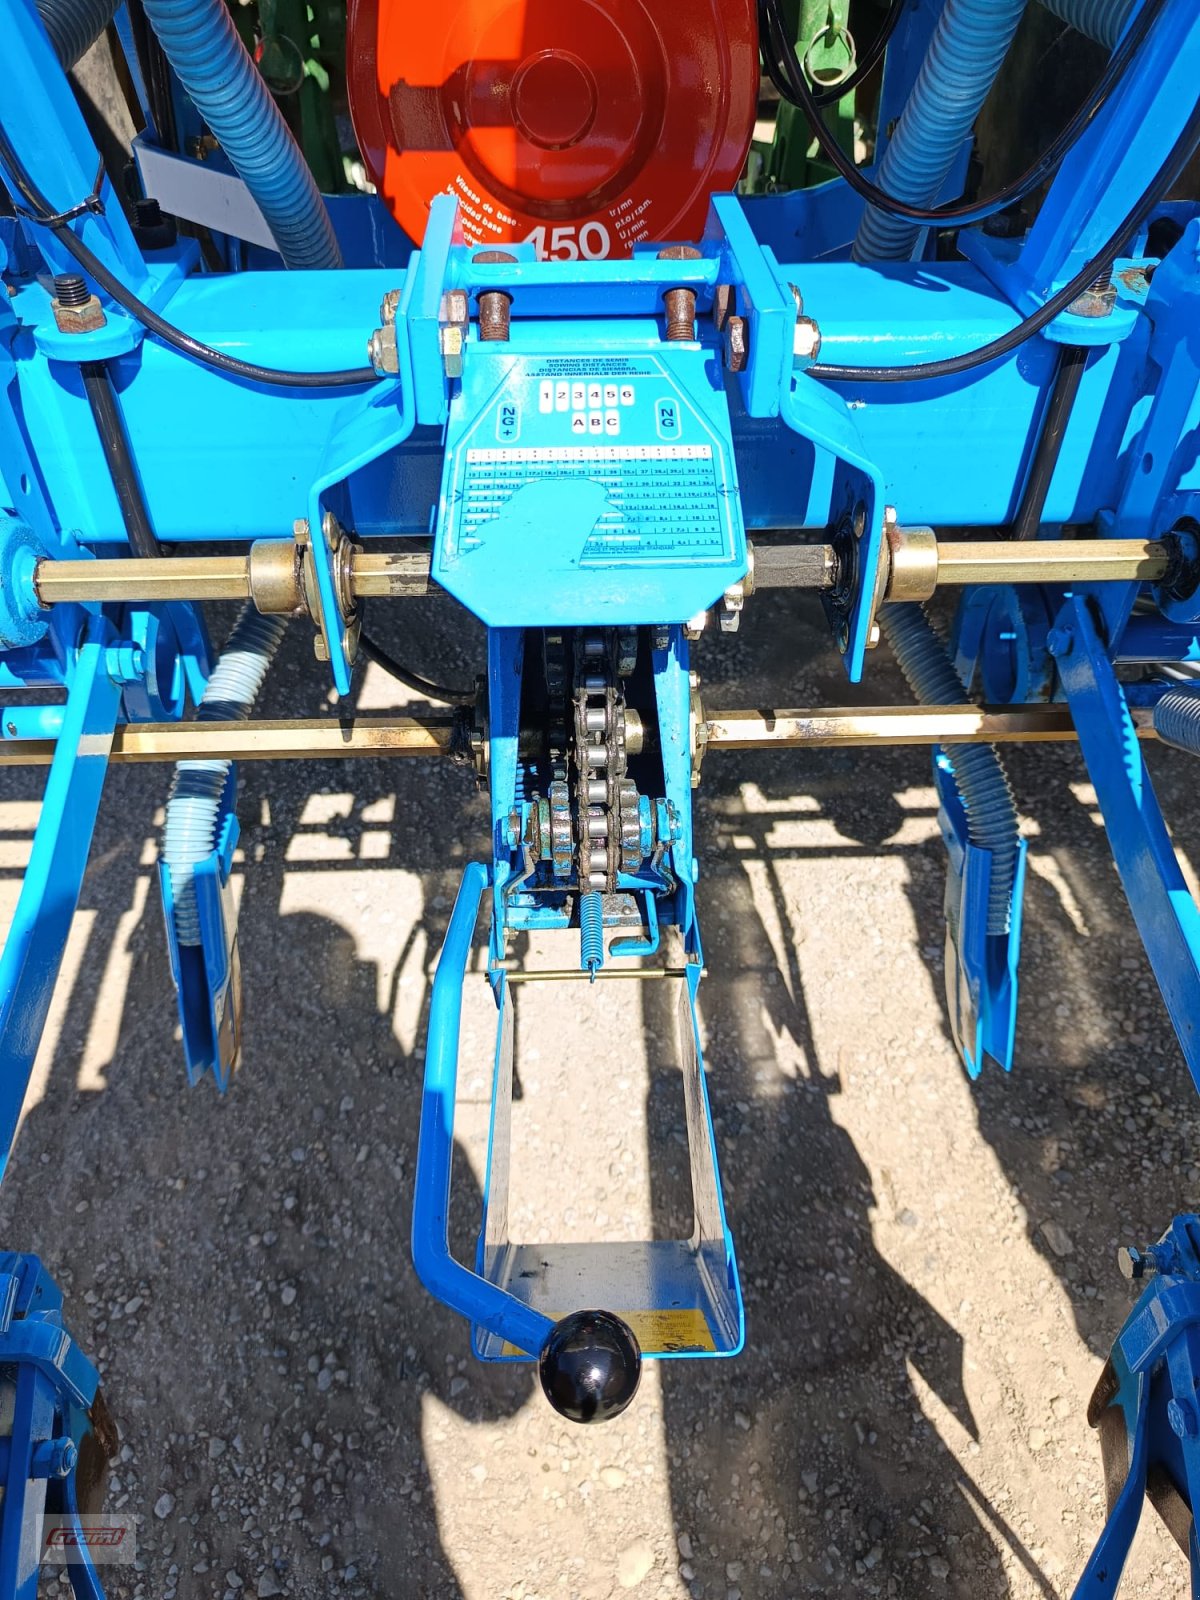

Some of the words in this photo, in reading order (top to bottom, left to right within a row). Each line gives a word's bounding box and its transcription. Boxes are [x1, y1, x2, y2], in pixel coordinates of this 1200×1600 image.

[456, 175, 480, 204] Vitesse
[483, 203, 493, 214] de
[496, 211, 516, 226] base
[482, 217, 502, 234] base
[522, 221, 610, 260] 450
